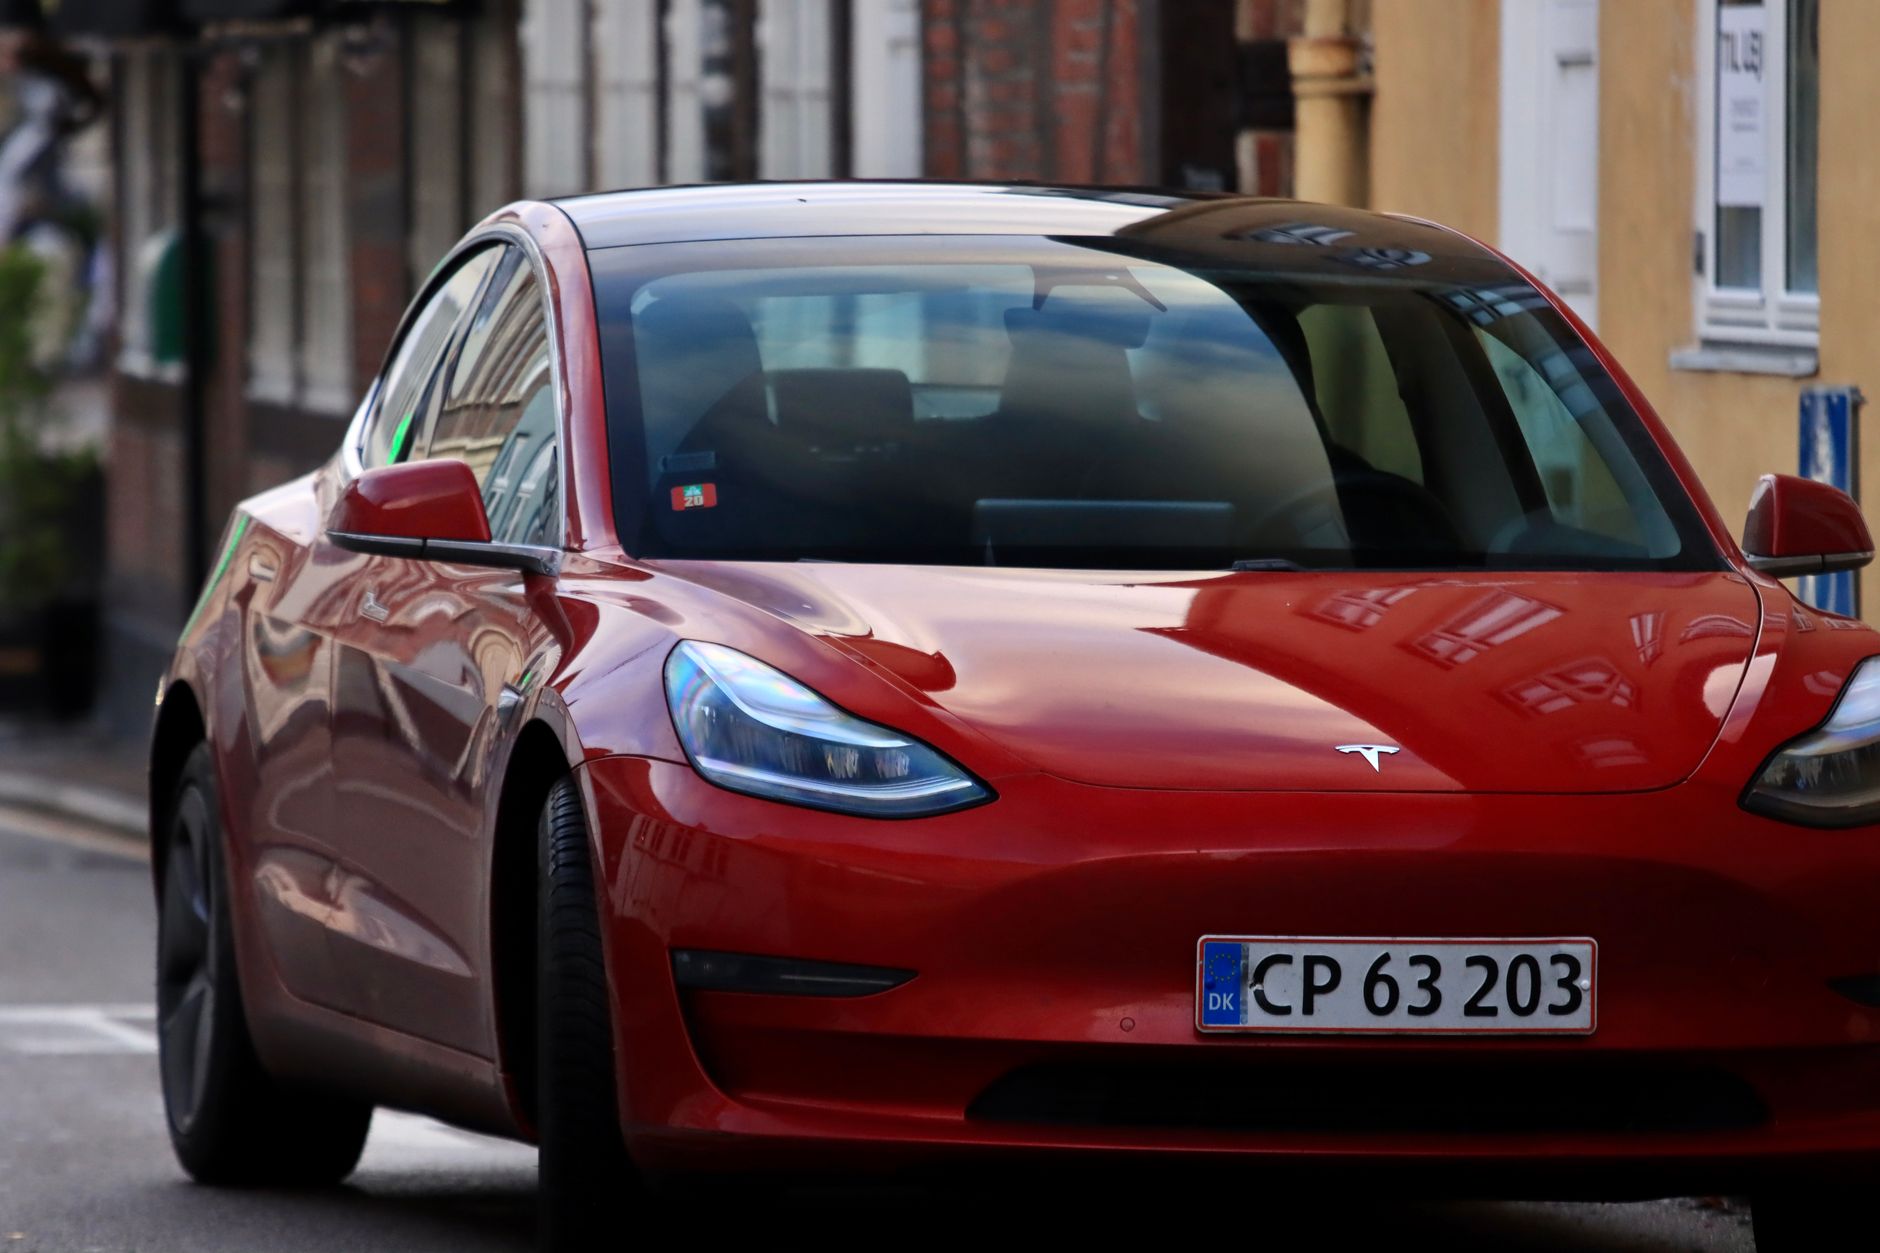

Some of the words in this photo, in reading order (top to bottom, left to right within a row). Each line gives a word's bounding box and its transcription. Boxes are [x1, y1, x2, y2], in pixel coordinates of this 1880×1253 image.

[684, 496, 704, 507] 20
[1251, 953, 1341, 1016] CP
[1363, 951, 1442, 1017] 63
[1464, 953, 1583, 1017] 203
[1208, 993, 1234, 1011] DK
